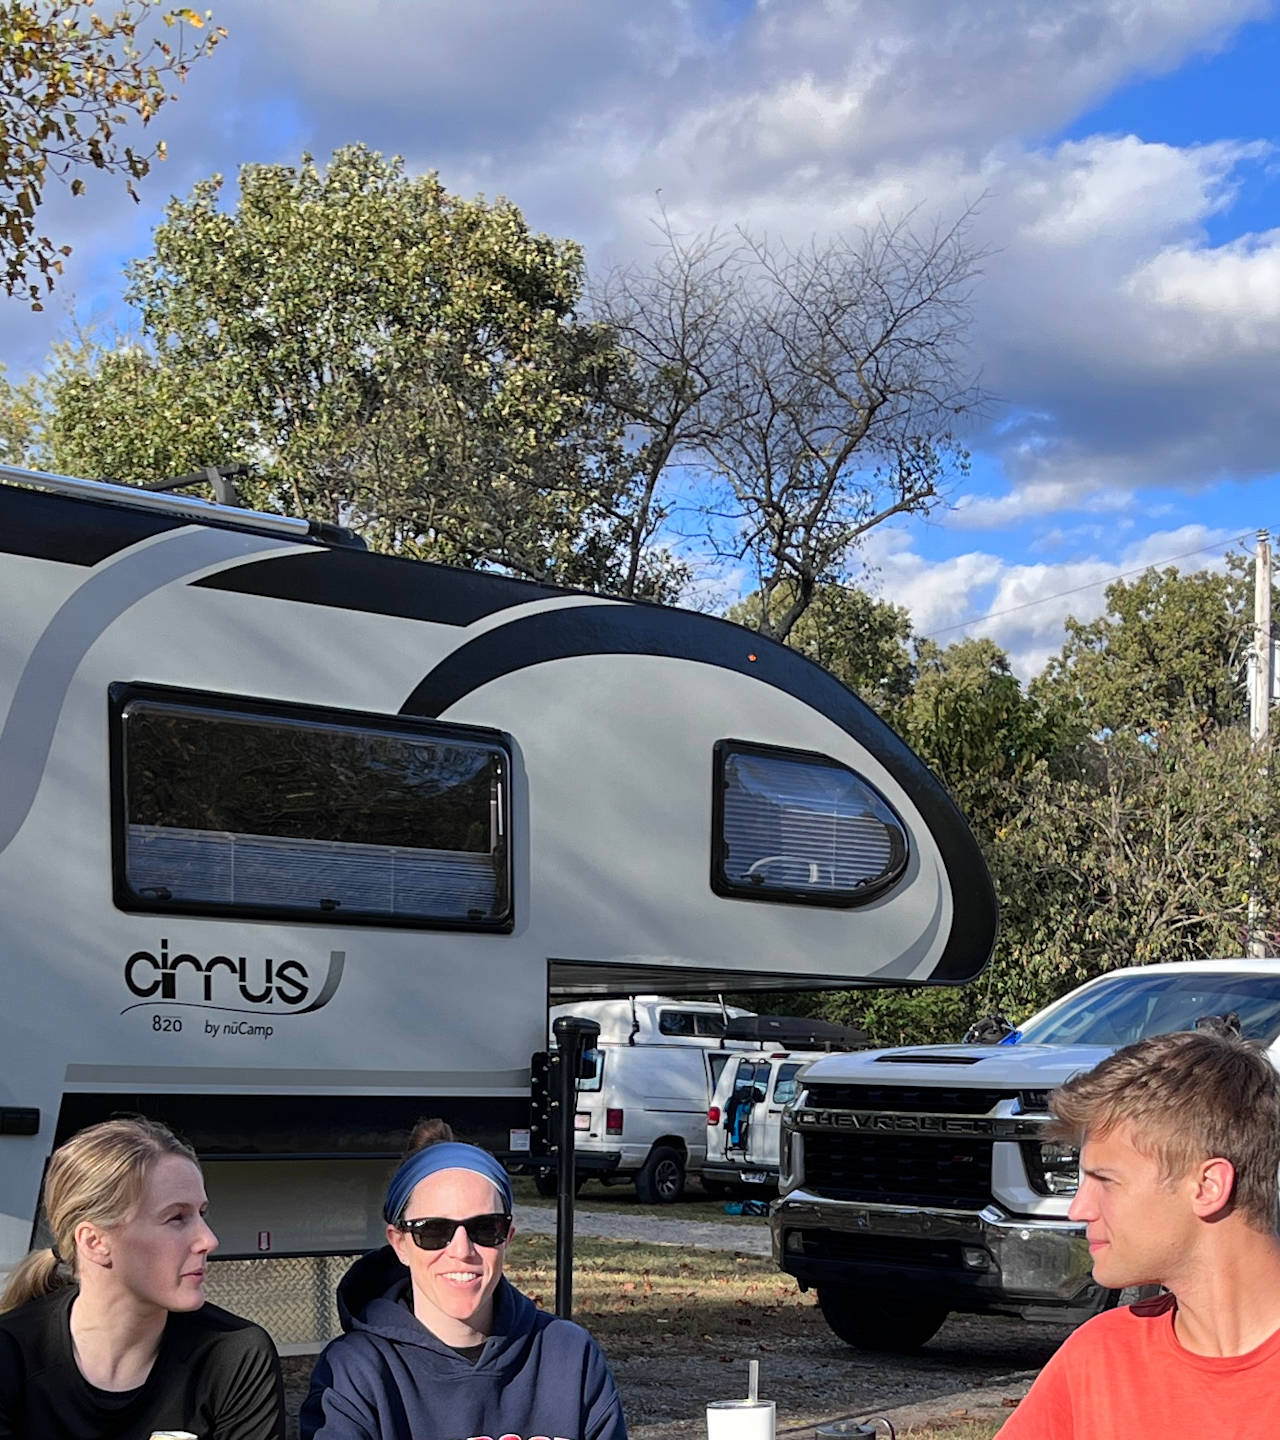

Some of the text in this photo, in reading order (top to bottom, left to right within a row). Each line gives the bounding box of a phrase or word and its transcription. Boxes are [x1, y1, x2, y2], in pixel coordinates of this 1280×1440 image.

[125, 939, 309, 1005] cirrus
[152, 1015, 183, 1032] 820
[204, 1018, 220, 1038] by
